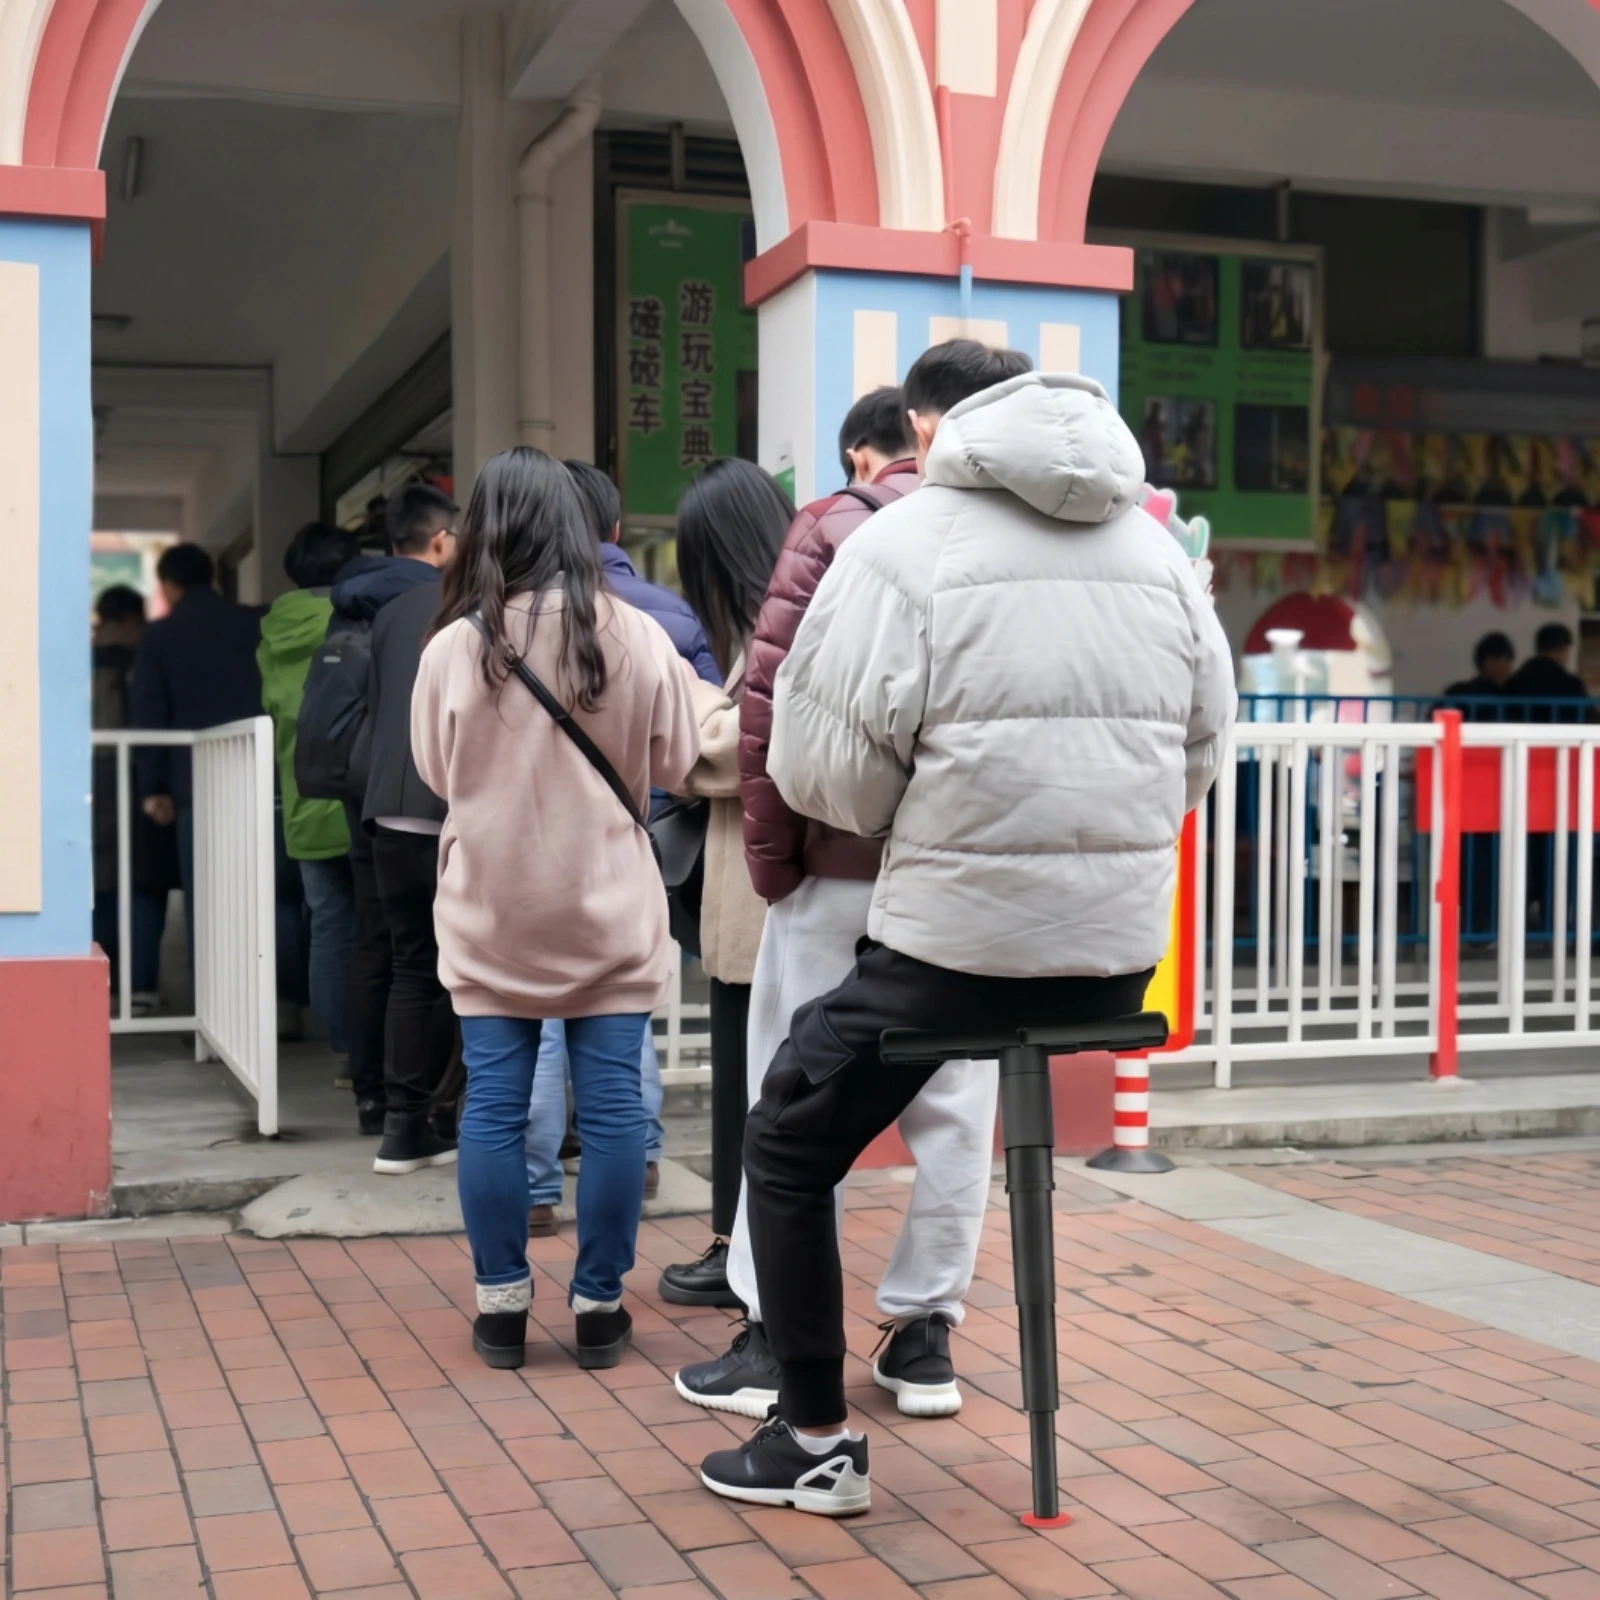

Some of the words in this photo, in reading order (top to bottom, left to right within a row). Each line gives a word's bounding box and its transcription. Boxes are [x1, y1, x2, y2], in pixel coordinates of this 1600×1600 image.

[628, 300, 661, 434] 碰碰车
[681, 281, 713, 466] 游玩宝典
